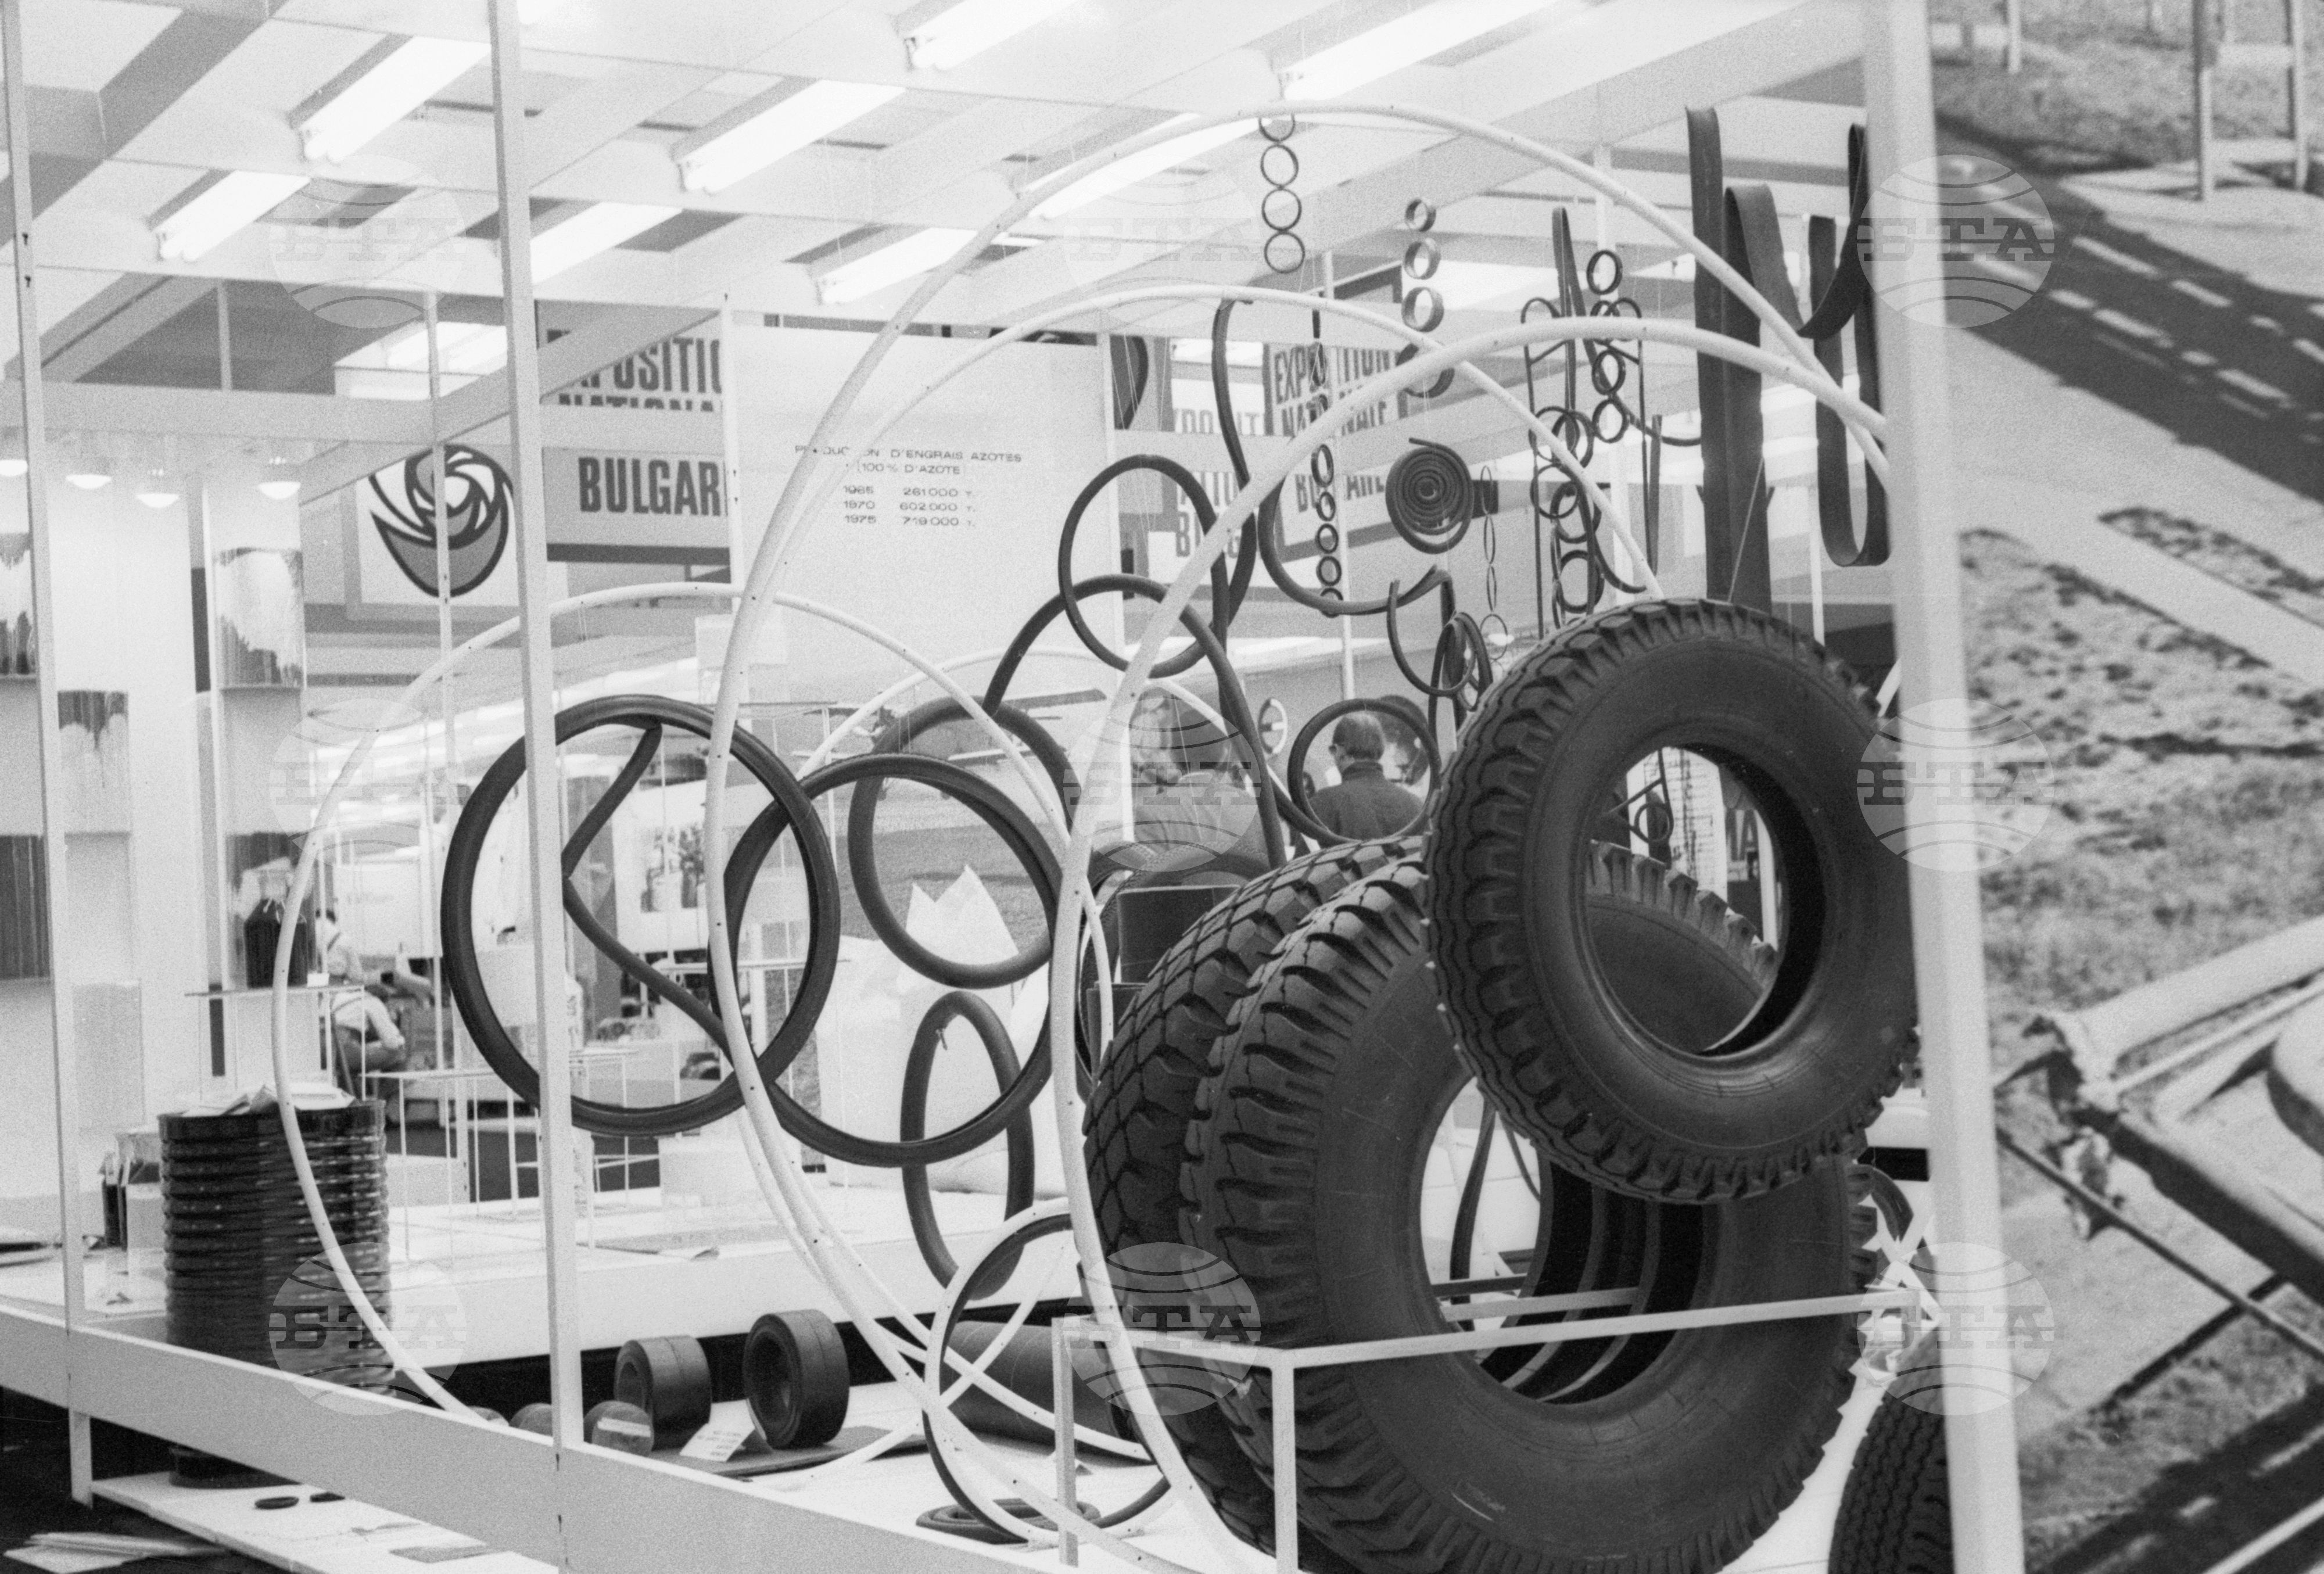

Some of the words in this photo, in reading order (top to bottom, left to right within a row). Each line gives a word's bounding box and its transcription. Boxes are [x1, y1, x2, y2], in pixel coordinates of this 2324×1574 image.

[891, 449, 963, 460] D'ENGRAIS
[579, 457, 721, 516] BULGAR
[843, 500, 875, 509] 1970
